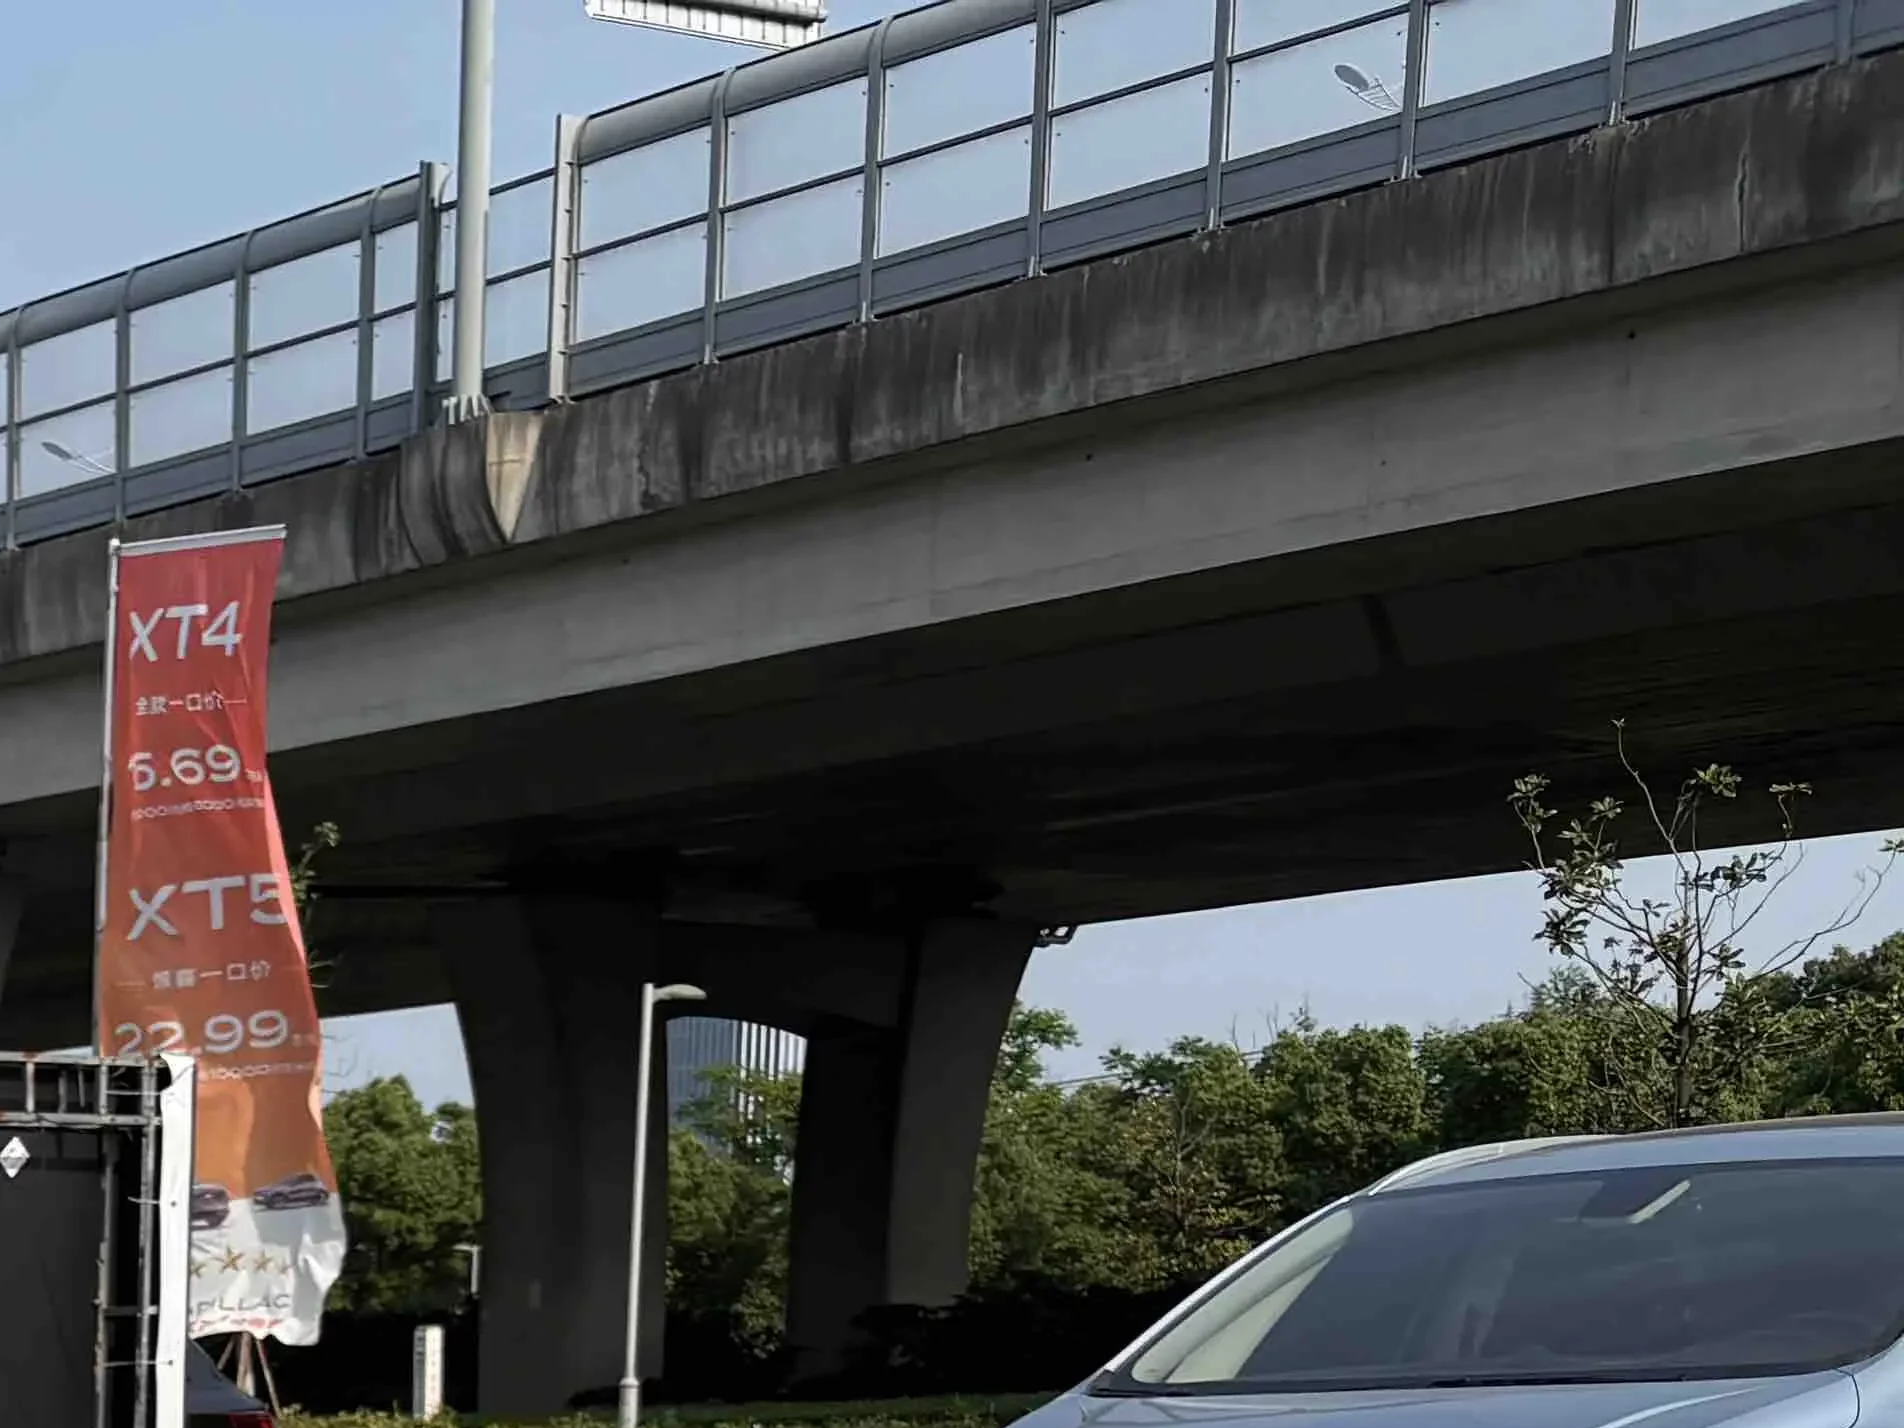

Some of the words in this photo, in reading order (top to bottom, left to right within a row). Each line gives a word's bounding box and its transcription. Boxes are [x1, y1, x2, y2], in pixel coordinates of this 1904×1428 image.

[129, 601, 243, 662] XT4
[126, 872, 288, 941] XT5
[115, 1009, 288, 1056] 22.99
